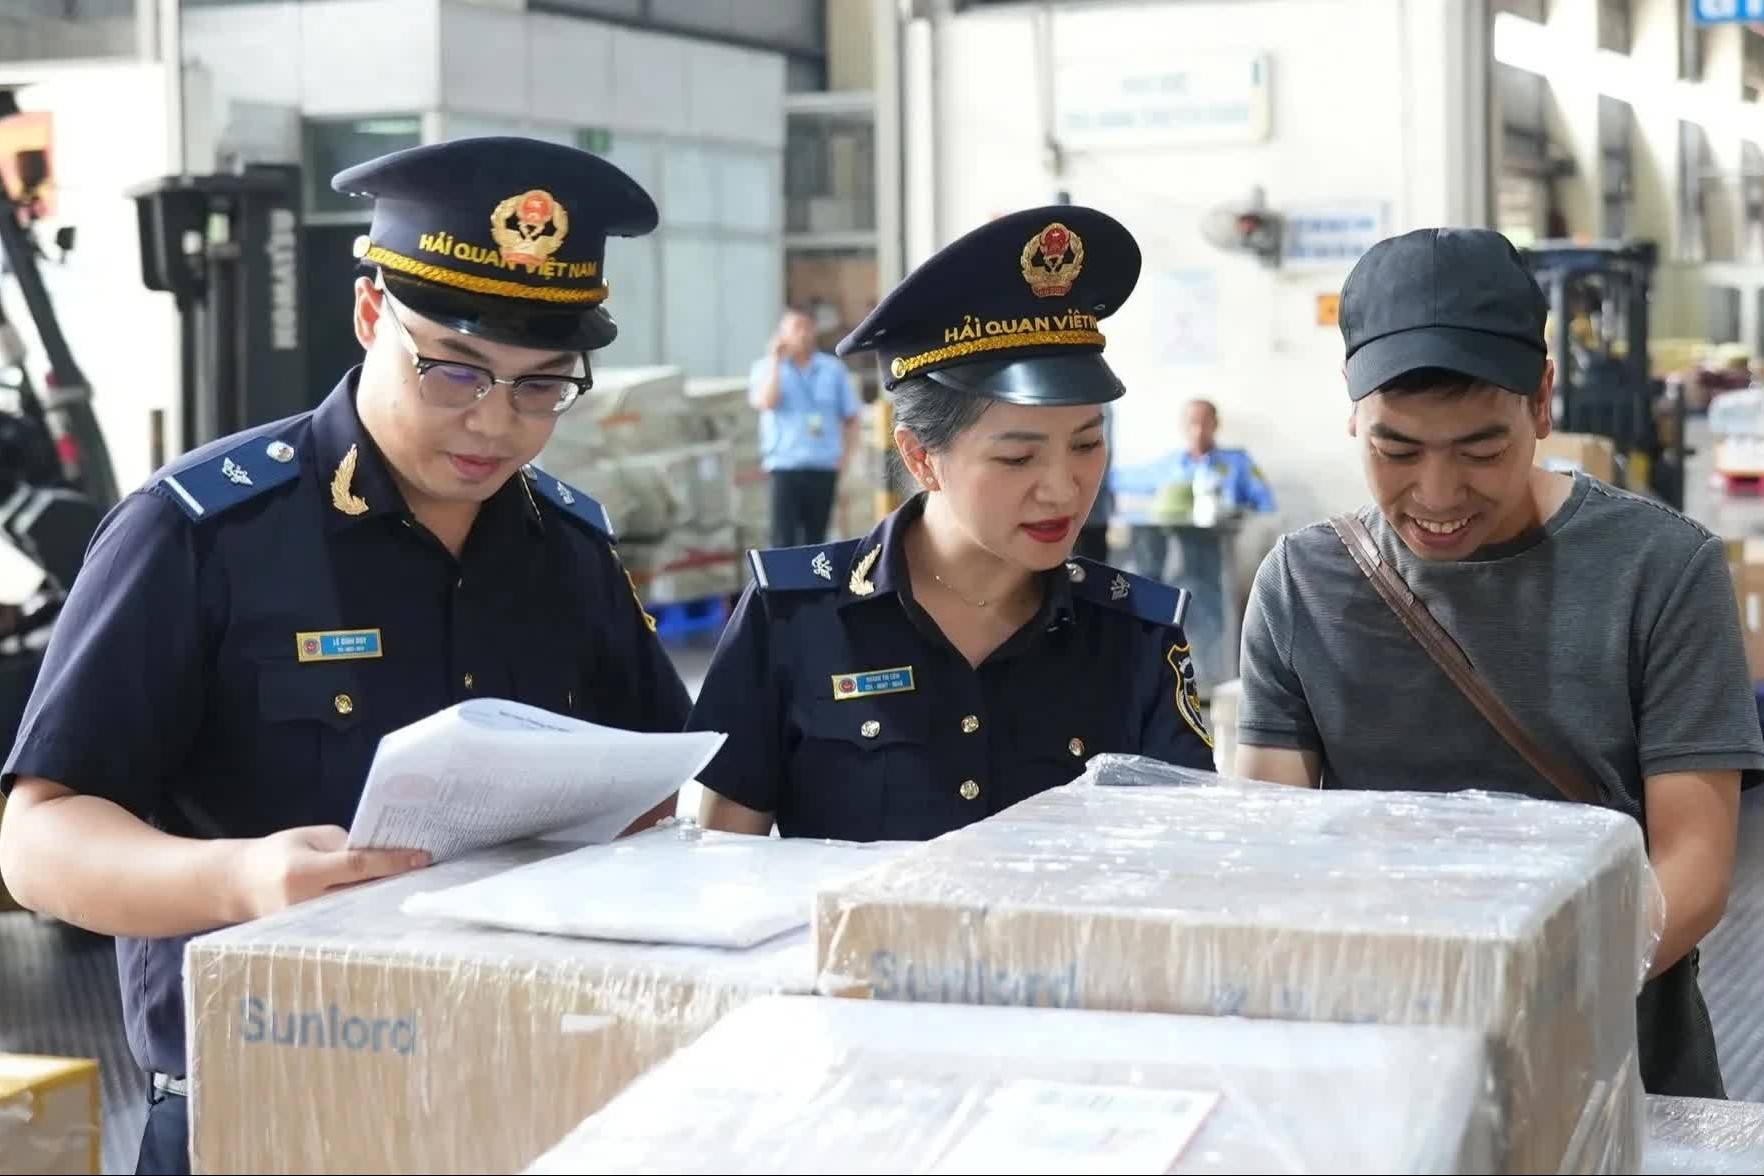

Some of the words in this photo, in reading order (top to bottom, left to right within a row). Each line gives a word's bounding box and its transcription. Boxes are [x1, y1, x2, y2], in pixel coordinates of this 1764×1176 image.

[267, 209, 297, 348] KOMATSU
[418, 231, 453, 256] HẢI
[568, 260, 597, 278] NAM
[944, 315, 982, 343] HẢI
[985, 317, 1050, 336] QUAN
[240, 997, 416, 1055] Sunlord
